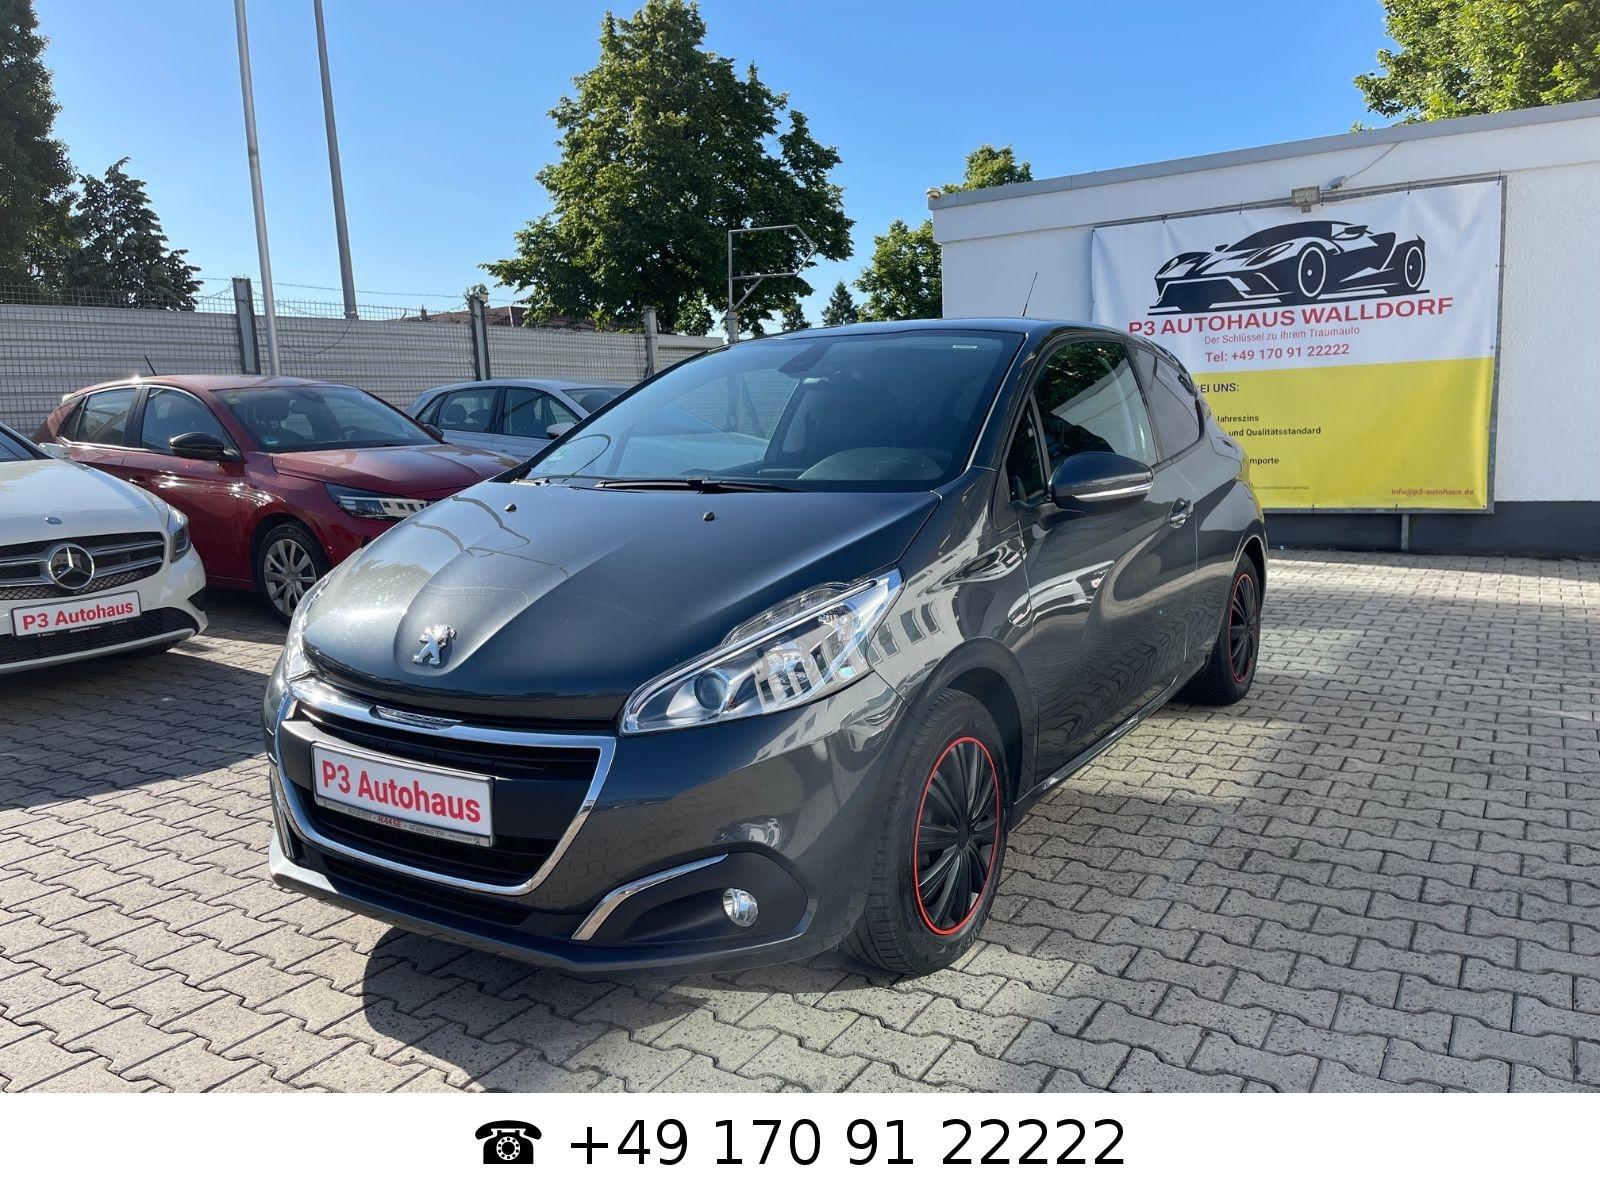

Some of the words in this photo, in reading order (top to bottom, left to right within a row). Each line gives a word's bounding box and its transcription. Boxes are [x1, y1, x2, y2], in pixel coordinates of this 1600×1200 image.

[1129, 321, 1156, 336] P3
[1160, 310, 1296, 335] AUTOHAUS
[1302, 297, 1454, 325] WALLDORF
[1204, 336, 1219, 345] Der
[1222, 331, 1264, 344] Schlüssel
[1266, 332, 1278, 340] zu
[1280, 331, 1306, 339] Ihrem
[1309, 326, 1360, 337] Traumauto
[1205, 351, 1228, 363] Tel:
[1231, 349, 1255, 361] +49
[1259, 347, 1283, 360] 170
[1287, 346, 1301, 358] 91
[1307, 343, 1350, 357] 22222
[1197, 384, 1210, 393] EI
[1213, 382, 1240, 393] UNS:
[1228, 428, 1244, 437] und
[1246, 426, 1322, 436] Qualitätsstandard
[1249, 457, 1280, 466] mporte
[1391, 488, 1475, 498] info@p3-autohaus.de
[22, 613, 49, 631] P3
[55, 602, 133, 625] Autohaus
[322, 760, 351, 794] P3
[358, 770, 481, 823] Autohaus
[378, 815, 401, 828] HAASE
